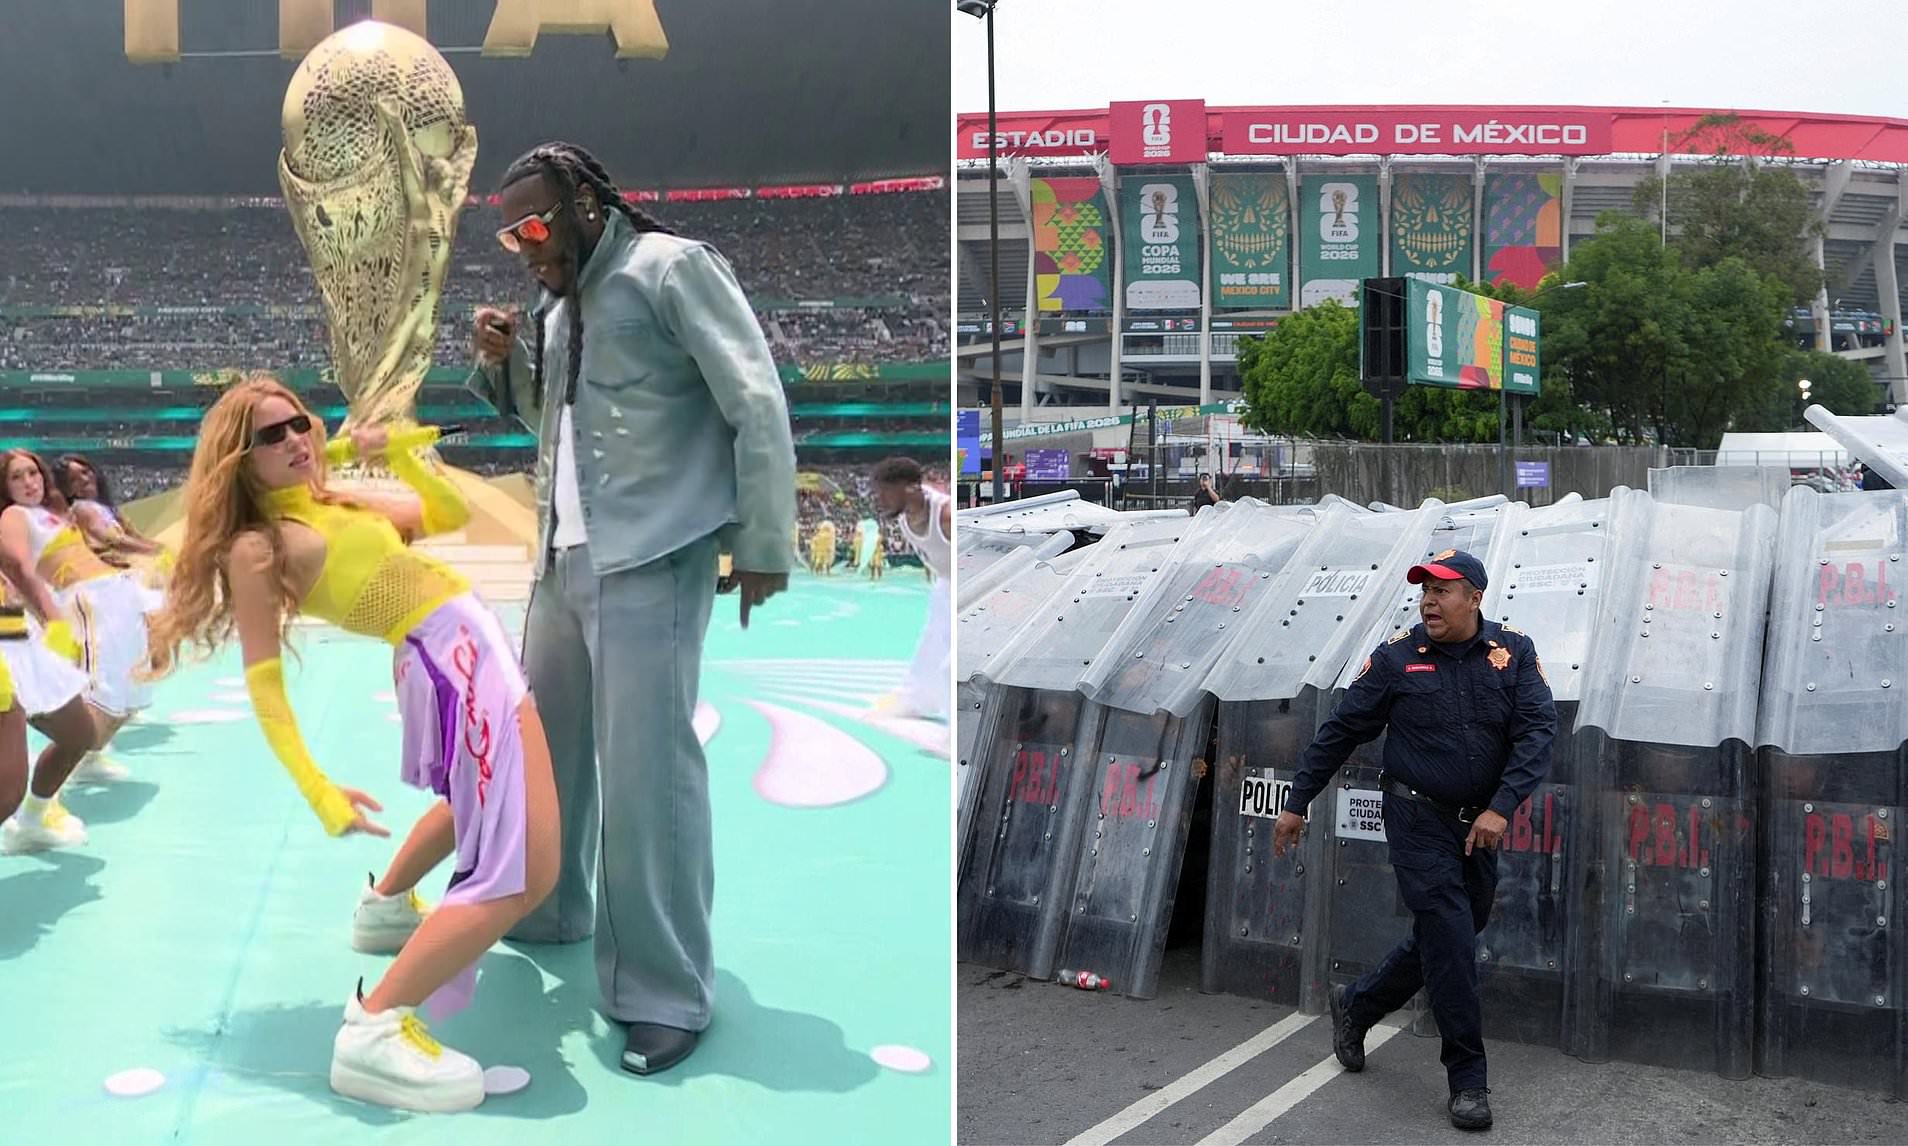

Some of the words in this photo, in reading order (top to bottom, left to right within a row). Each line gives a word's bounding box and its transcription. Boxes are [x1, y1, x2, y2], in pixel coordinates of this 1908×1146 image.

[972, 129, 1095, 149] ESTADIO
[1249, 123, 1379, 144] CIUDAD
[1395, 123, 1441, 144] DE
[1452, 119, 1587, 144] MÉXICO
[1142, 245, 1180, 256] COPA
[1320, 250, 1359, 260] 2026
[1142, 256, 1180, 264] MUNDIAL
[1142, 264, 1181, 274] 2026
[1003, 426, 1038, 439] UNDIAL
[1087, 416, 1120, 428] 2026
[1818, 560, 1897, 608] P.B.I.
[1350, 798, 1382, 809] PROTE
[1349, 808, 1382, 819] CIUDA
[1360, 820, 1382, 832] SSC
[1503, 793, 1561, 853] .B.I.
[1631, 804, 1709, 869] P.B.I.
[1805, 814, 1887, 881] P.B.I.
